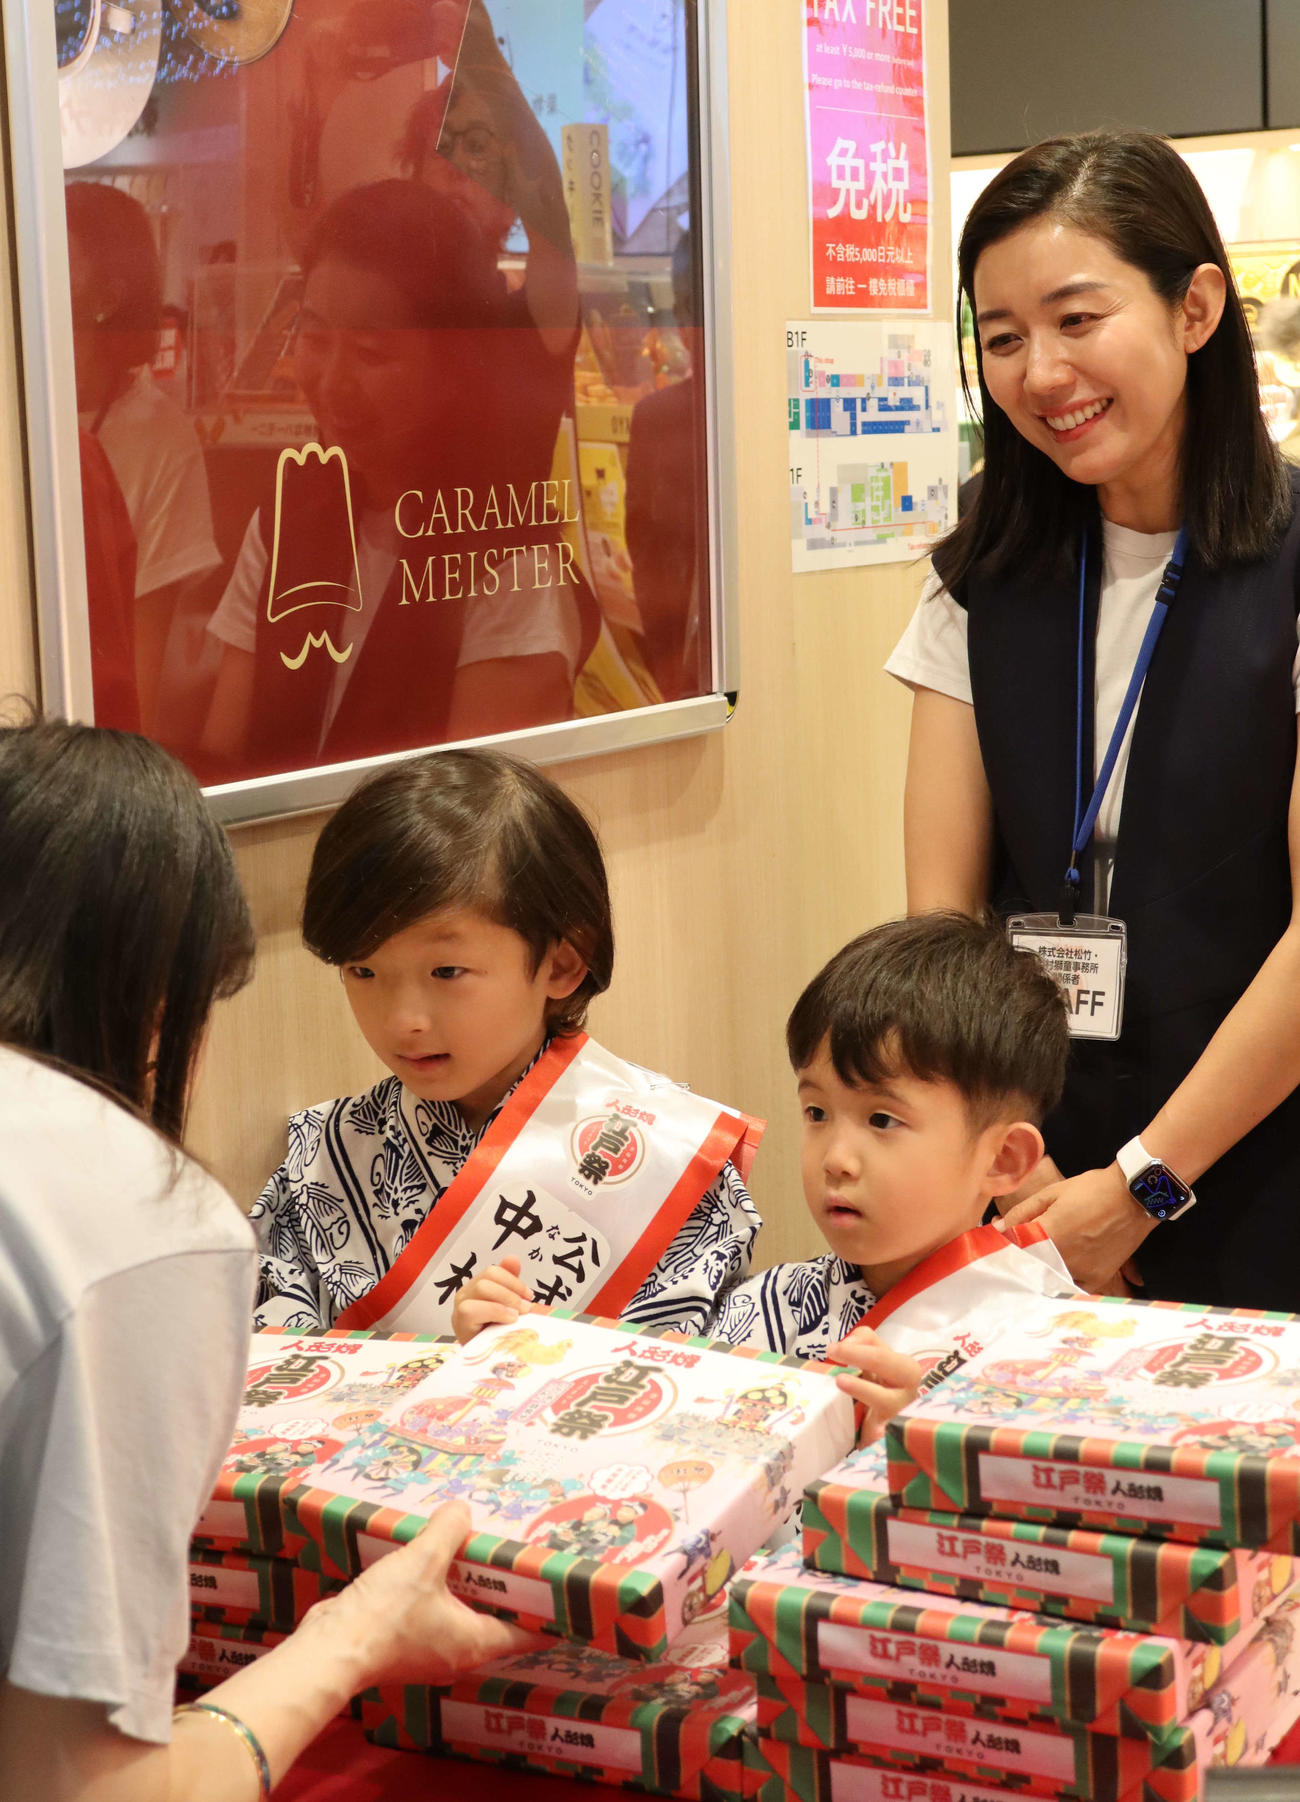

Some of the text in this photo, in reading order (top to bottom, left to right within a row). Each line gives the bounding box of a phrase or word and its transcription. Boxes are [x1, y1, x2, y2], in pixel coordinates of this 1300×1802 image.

[865, 0, 918, 34] FREE
[811, 73, 833, 86] Please
[833, 79, 842, 90] go
[843, 80, 850, 88] to
[851, 79, 862, 90] the
[786, 330, 807, 348] B1F
[790, 467, 802, 485] 1F
[394, 479, 580, 539] CARAMEL
[397, 542, 580, 606] MEISTER
[570, 1176, 593, 1196] TOKYO
[1032, 1464, 1107, 1497] 江戸祭
[1073, 1496, 1125, 1510] TOKYO
[936, 1532, 1007, 1567] 江戸祭
[975, 1566, 1024, 1582] TOKYO
[869, 1633, 941, 1668] 江戸祭
[908, 1668, 959, 1684] TOKYO
[896, 1709, 967, 1744] 江戸祭
[935, 1744, 985, 1760] TOKYO
